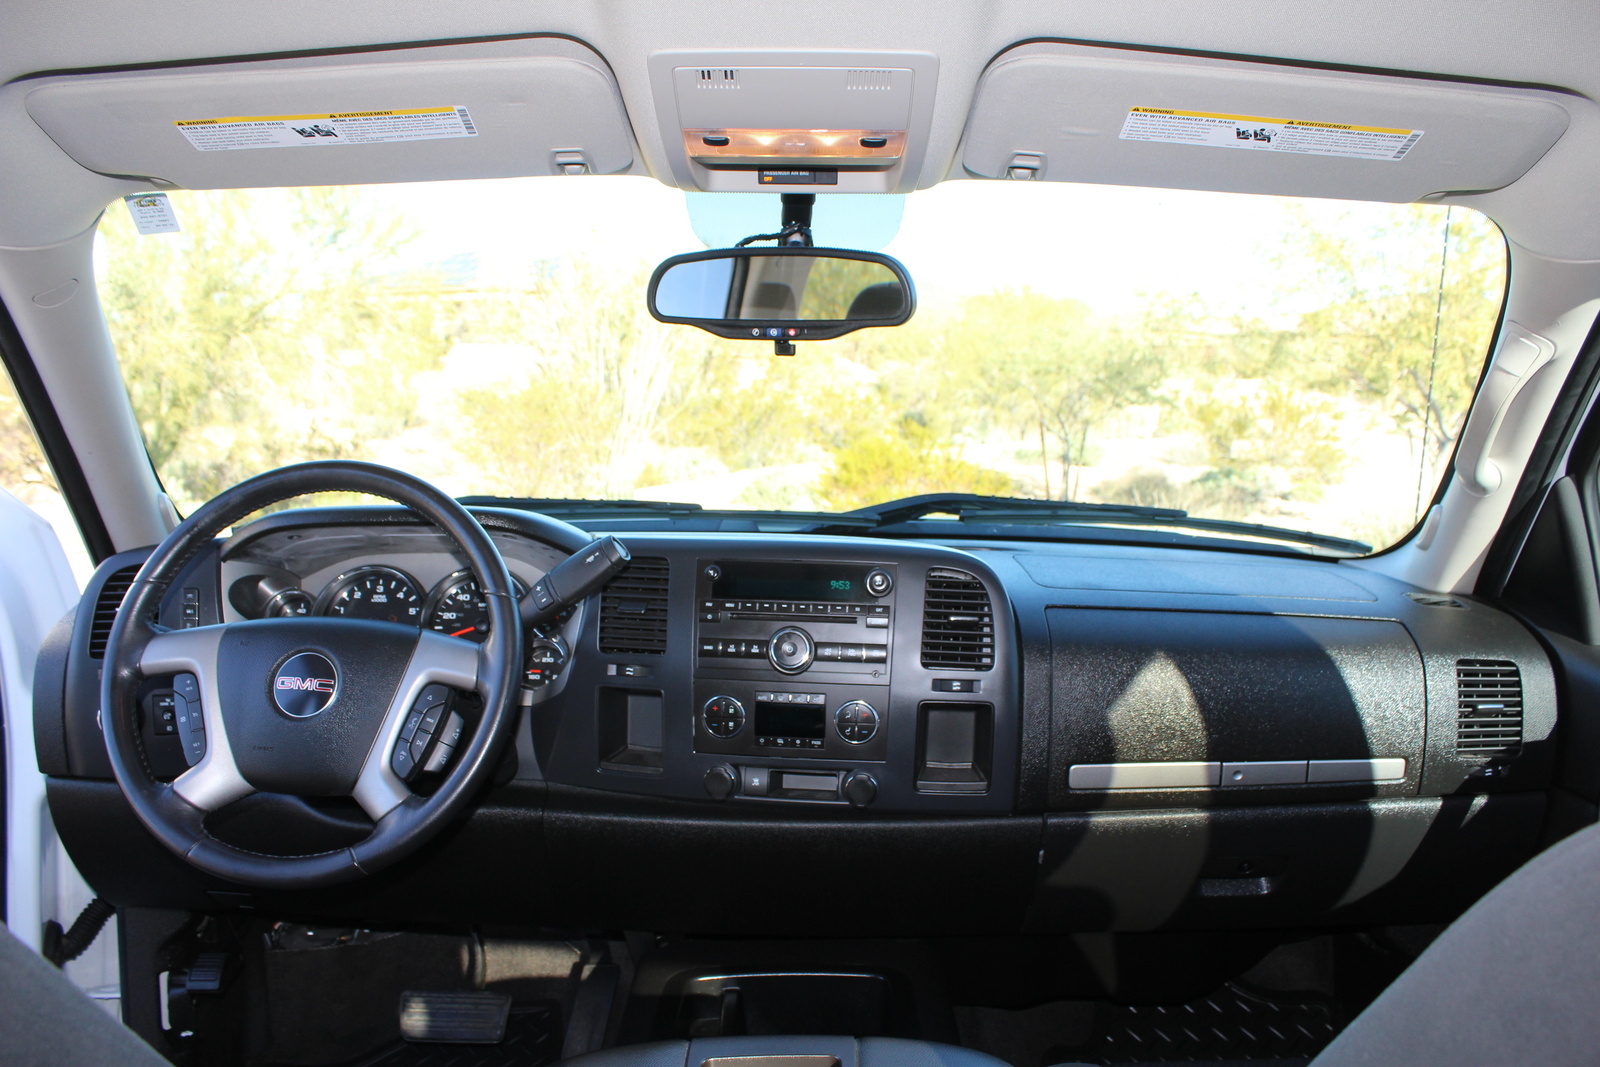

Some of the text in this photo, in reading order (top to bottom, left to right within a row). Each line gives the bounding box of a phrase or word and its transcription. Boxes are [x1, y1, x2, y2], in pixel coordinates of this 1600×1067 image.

[1296, 121, 1352, 130] AVERTISSEMENT
[830, 580, 850, 590] 9:53
[276, 676, 334, 692] GMC
